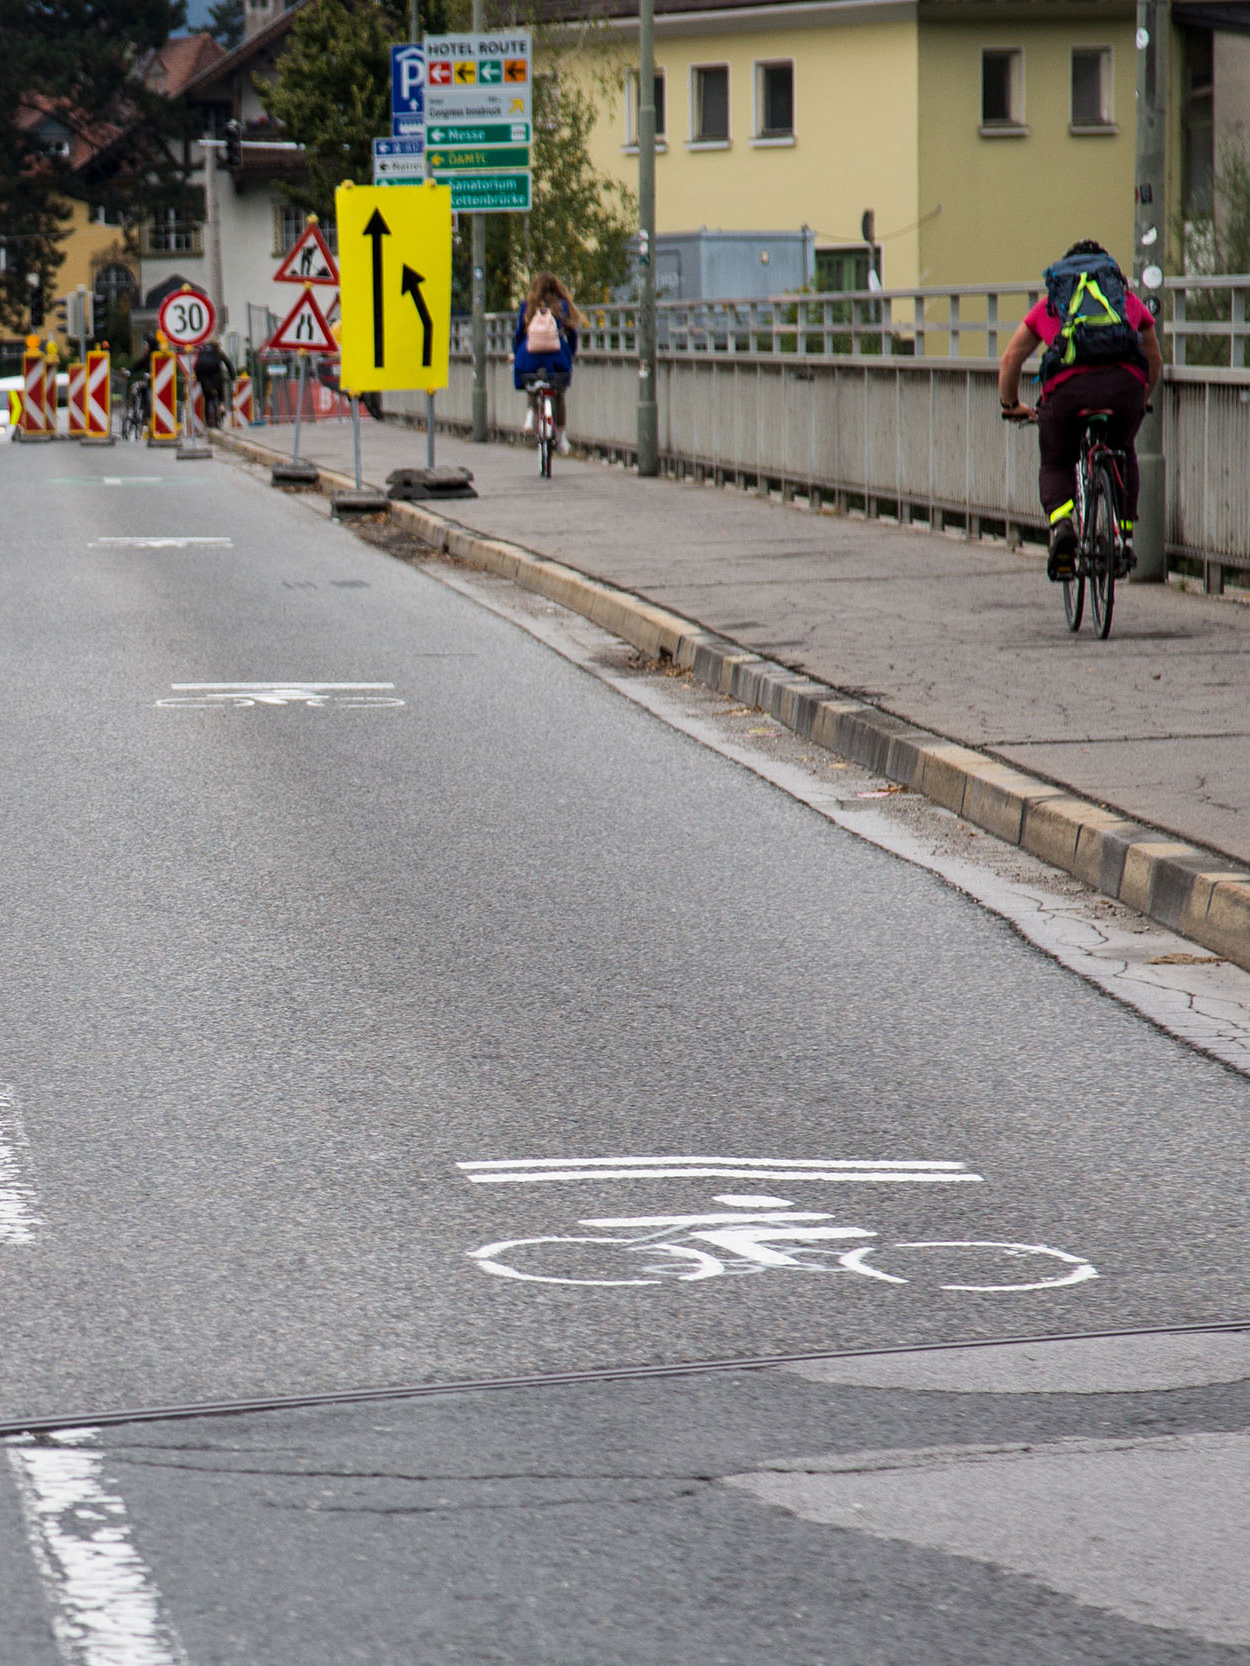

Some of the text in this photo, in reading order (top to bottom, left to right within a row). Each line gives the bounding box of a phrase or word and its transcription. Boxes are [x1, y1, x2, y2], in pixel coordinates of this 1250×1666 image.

[428, 40, 527, 56] HOTEL ROUTE
[401, 59, 424, 100] P
[447, 127, 486, 141] Messe
[448, 177, 517, 191] Sanatorium
[173, 303, 203, 332] 30
